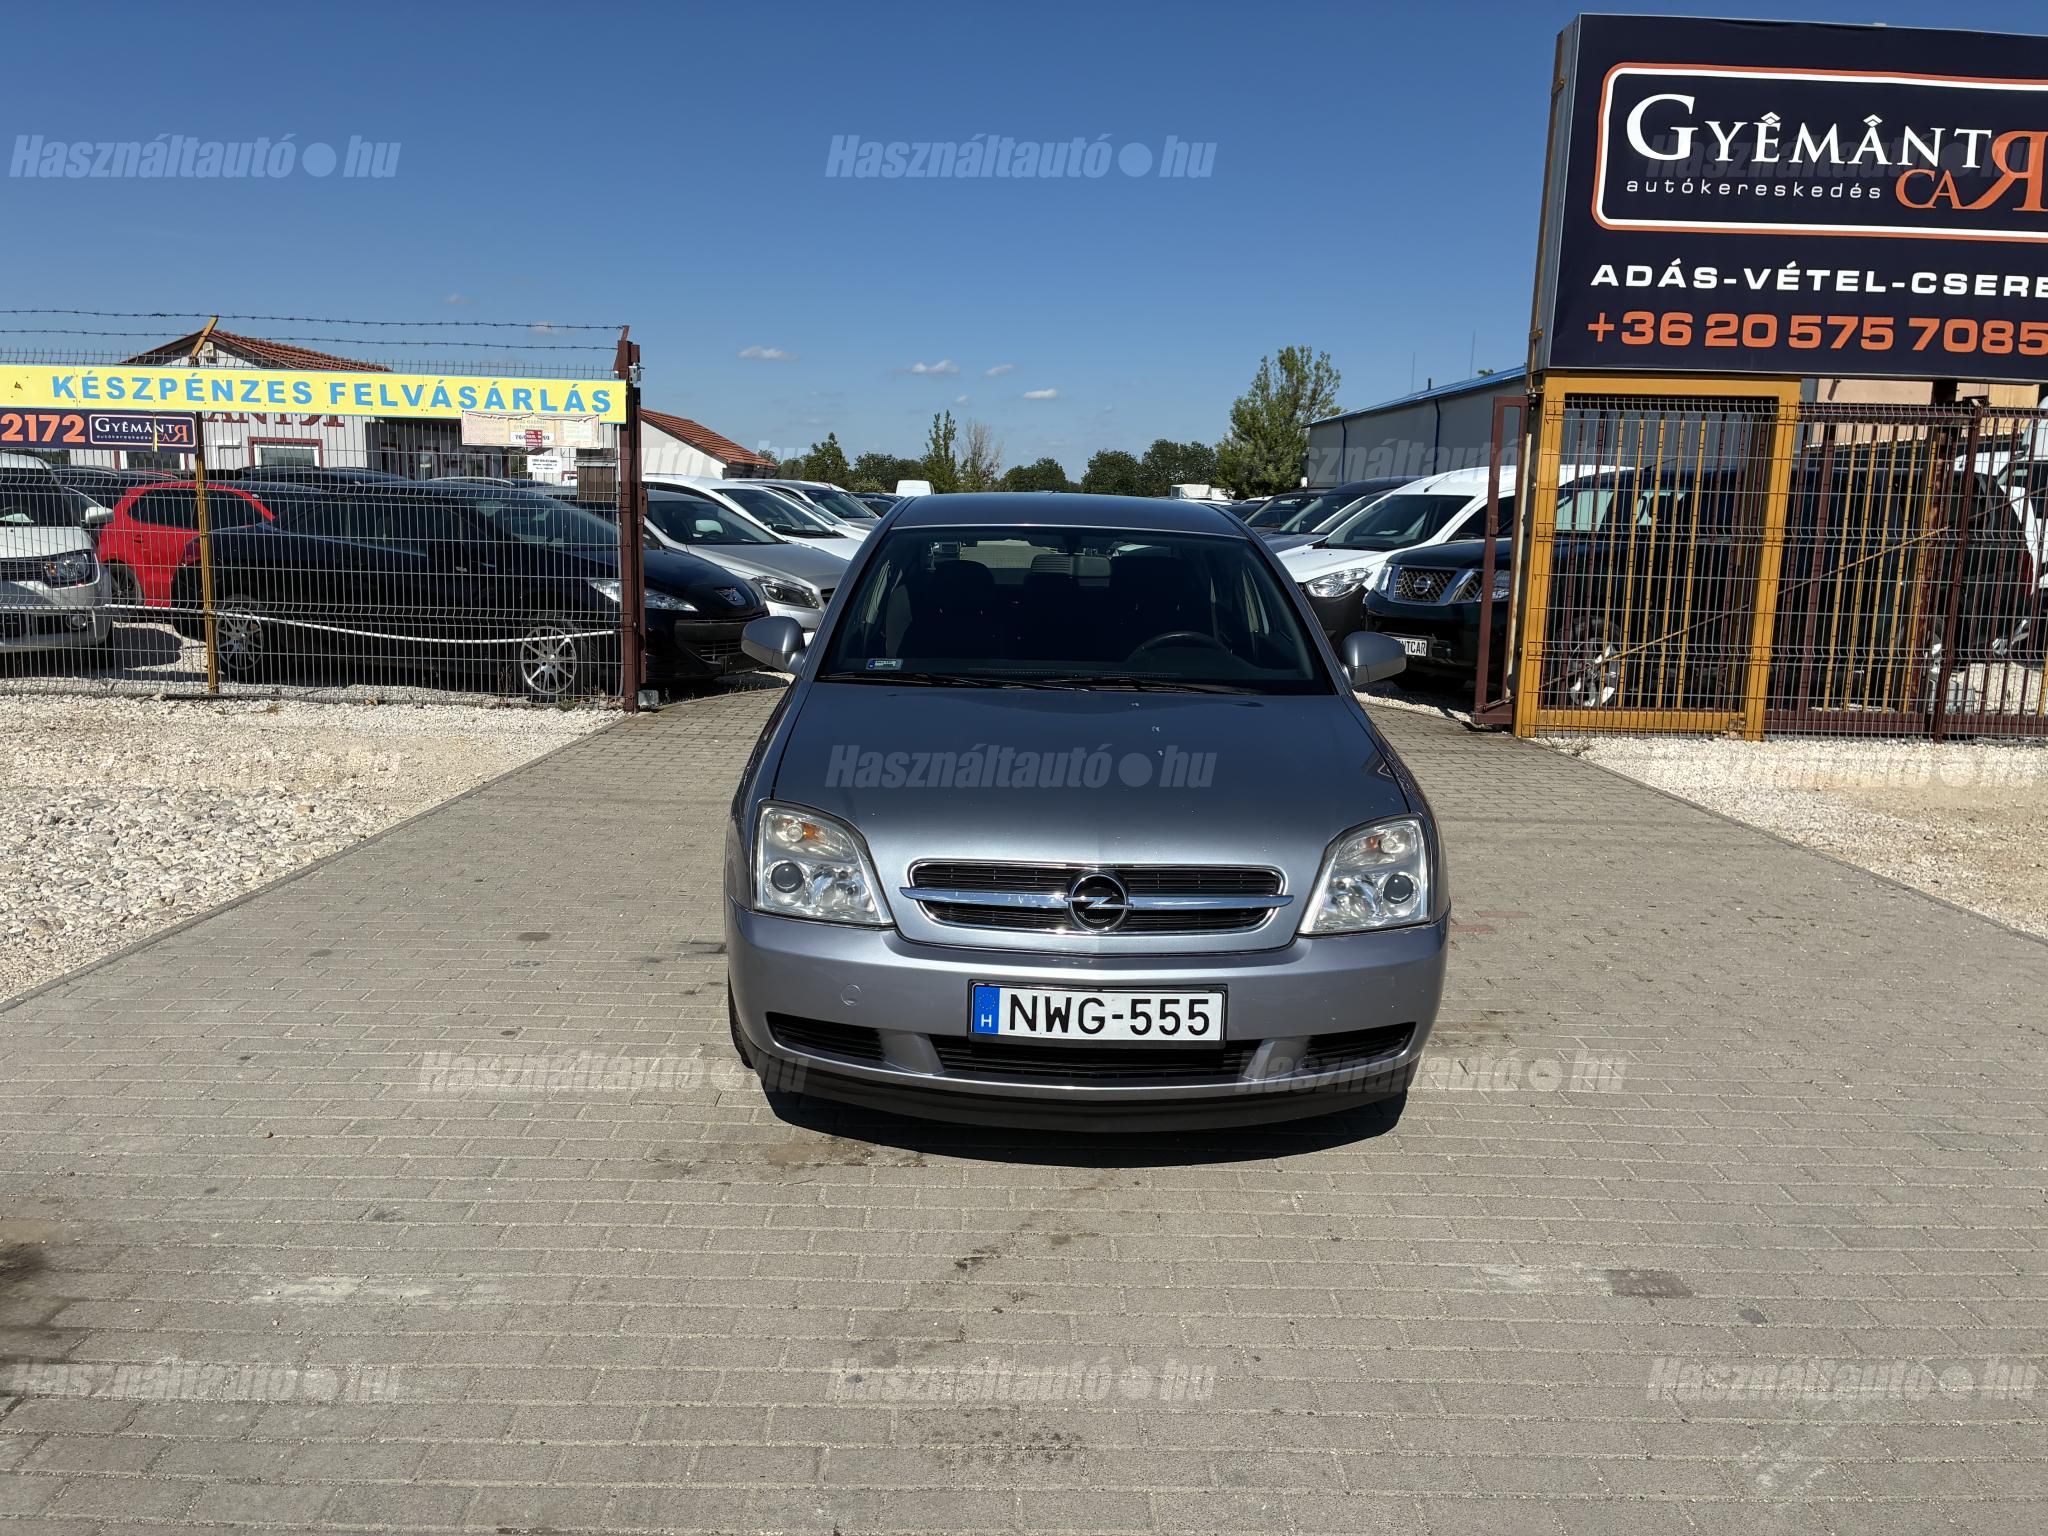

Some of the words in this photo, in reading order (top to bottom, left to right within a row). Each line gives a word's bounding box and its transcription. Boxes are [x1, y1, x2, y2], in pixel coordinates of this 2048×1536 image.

[1626, 177, 1881, 199] autókereskedés
[1587, 310, 1693, 346] +36
[1704, 313, 1777, 347] 20
[1788, 316, 1894, 351] 575
[1907, 318, 2048, 356] 7085
[52, 373, 313, 405] KÉSZPÉNZES
[329, 379, 611, 414] FELVÁSÁRLÁS
[0, 413, 86, 443] 2172
[1009, 993, 1210, 1036] NWG-555
